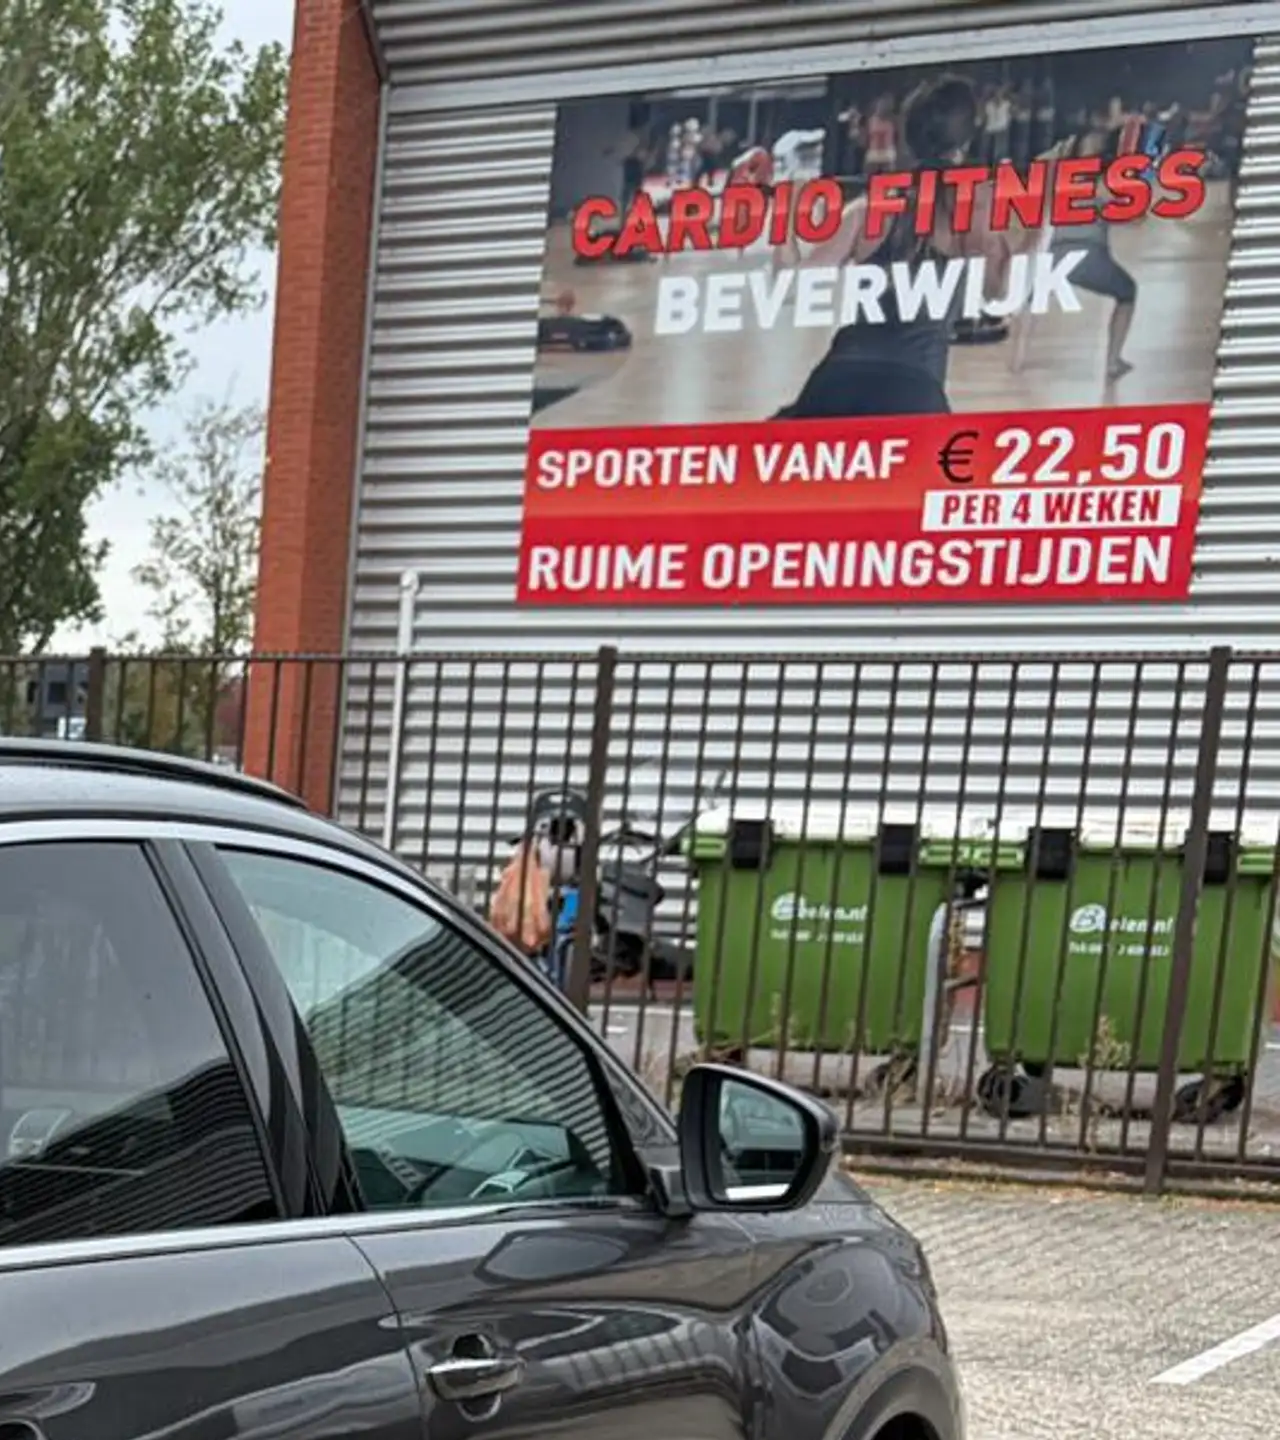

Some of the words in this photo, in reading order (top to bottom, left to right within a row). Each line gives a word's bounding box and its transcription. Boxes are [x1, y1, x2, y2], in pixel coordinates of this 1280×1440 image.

[571, 176, 844, 259] CARDIO
[864, 148, 1207, 240] FITNESS
[653, 249, 1090, 336] BEVERWIJK
[536, 444, 739, 489] SPORTEN
[753, 438, 909, 483] VANAF
[937, 430, 980, 484] €
[941, 492, 1000, 525] PER
[1011, 492, 1032, 525] 4
[1044, 488, 1162, 524] WEKEN
[527, 544, 689, 592] RUIME
[701, 535, 1172, 591] OPENINGSTIJDEN
